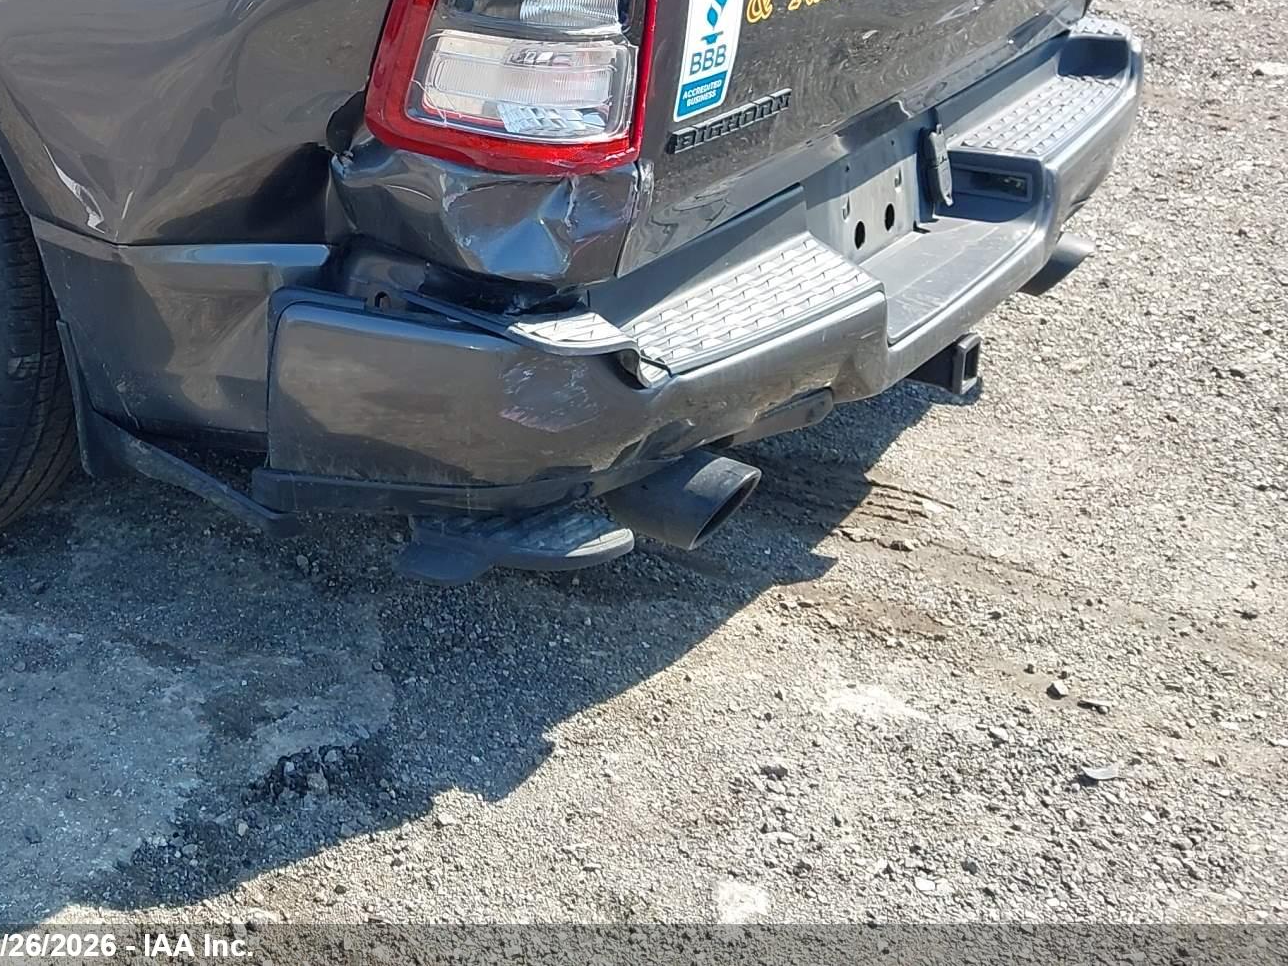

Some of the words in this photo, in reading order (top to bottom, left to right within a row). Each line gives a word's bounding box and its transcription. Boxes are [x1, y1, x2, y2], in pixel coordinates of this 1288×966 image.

[689, 43, 727, 76] BBB
[682, 79, 722, 101] ACCREDITED
[686, 89, 717, 107] BUSINESS
